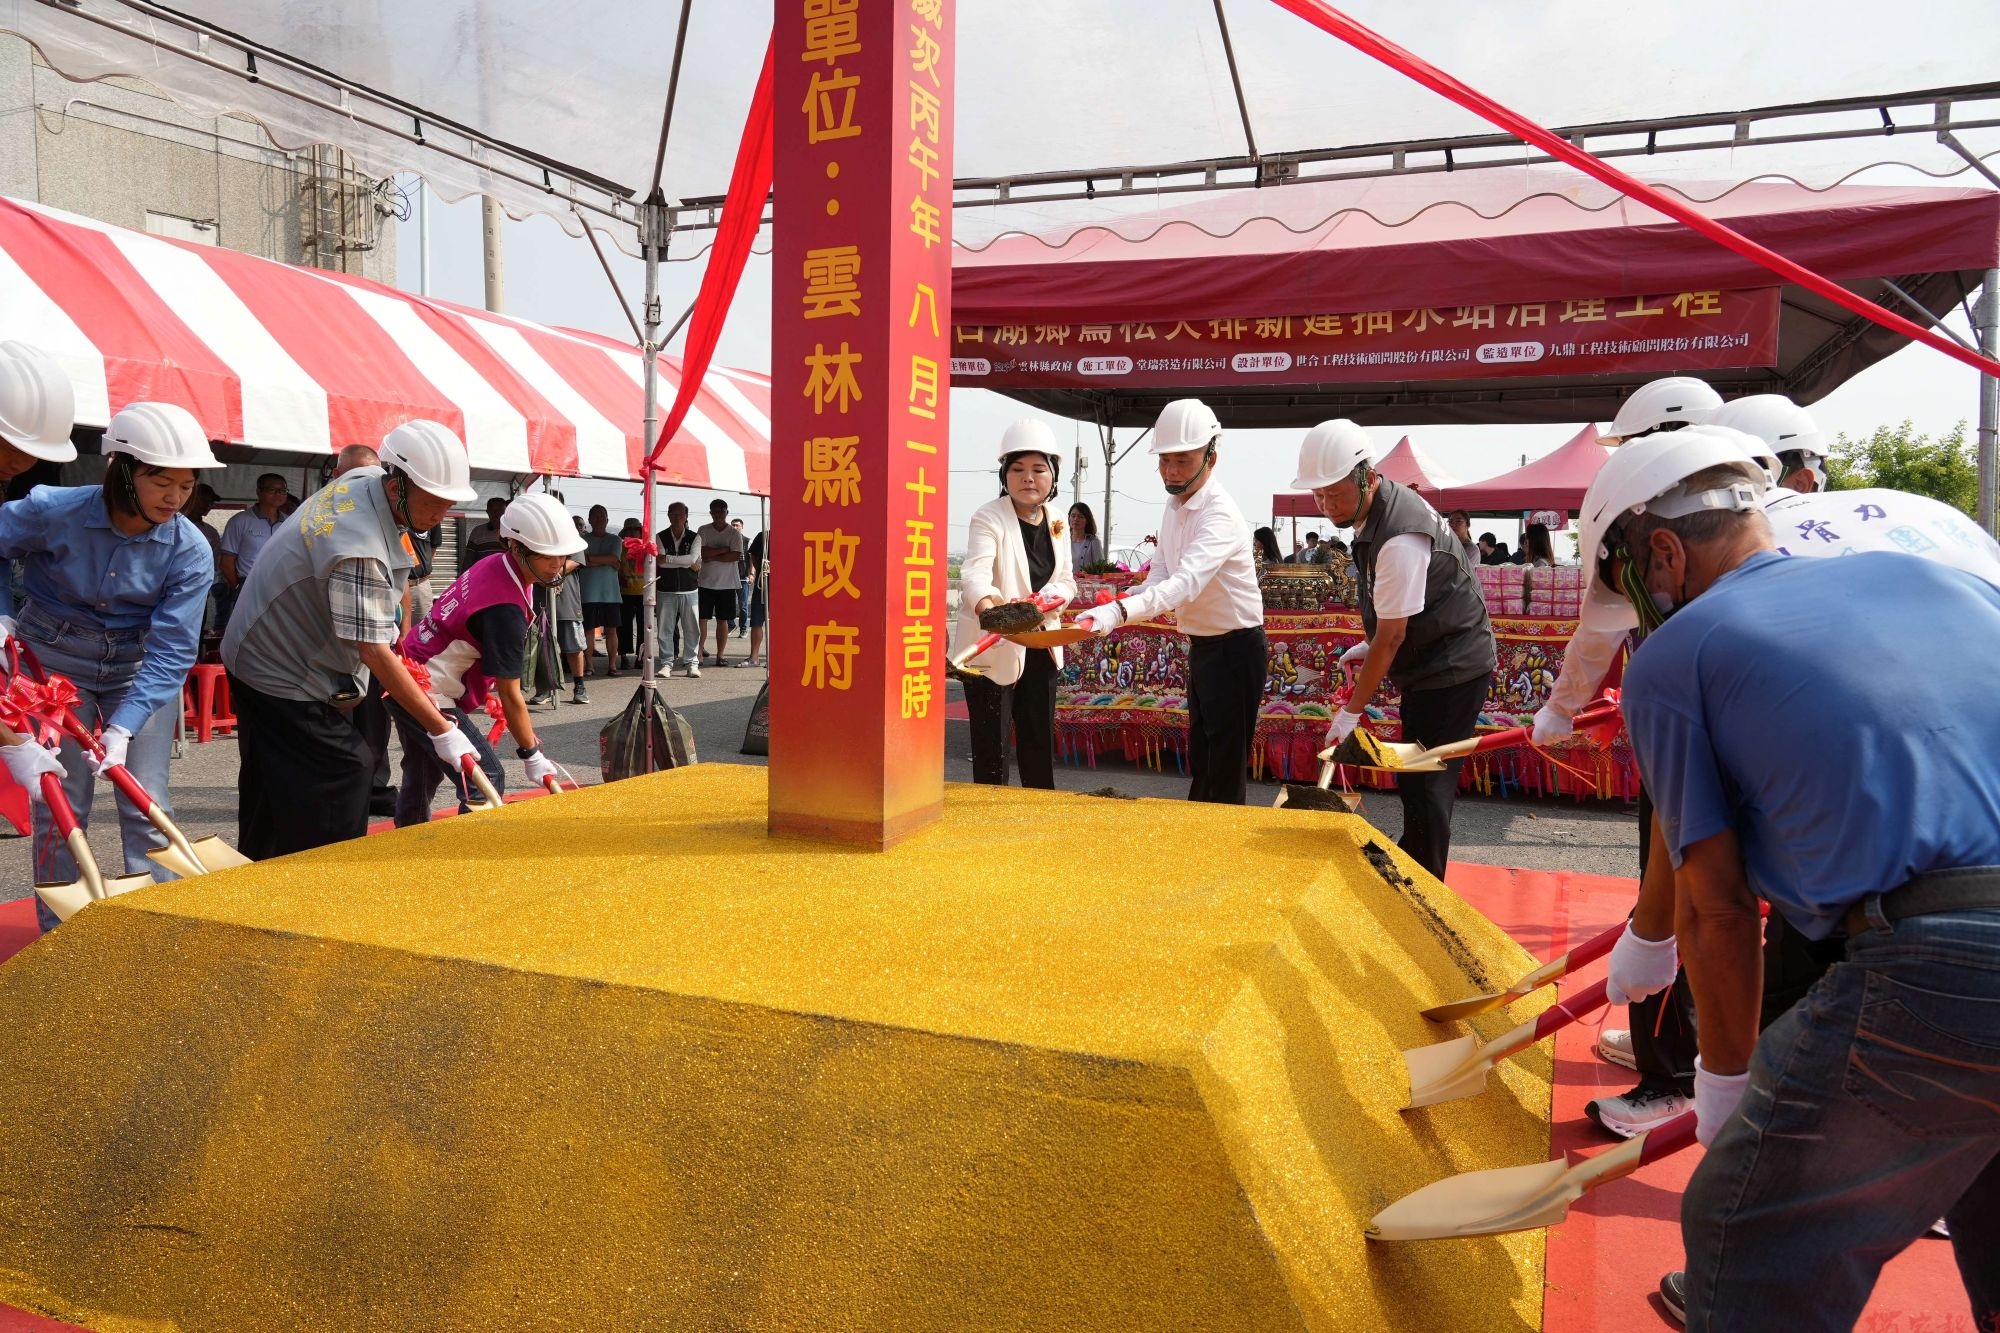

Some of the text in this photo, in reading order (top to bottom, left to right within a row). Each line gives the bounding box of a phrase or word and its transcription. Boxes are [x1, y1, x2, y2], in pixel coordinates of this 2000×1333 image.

[1018, 360, 1073, 372] 雲林縣政府
[1082, 360, 1127, 372] 施工單位
[1237, 356, 1285, 369] 設計單位
[1296, 348, 1470, 368] 世合工程技術顧問股份有限公司
[1482, 345, 1537, 360] 監造單位
[1548, 332, 1749, 357] 九鼎工程技術顧問股份有限公司
